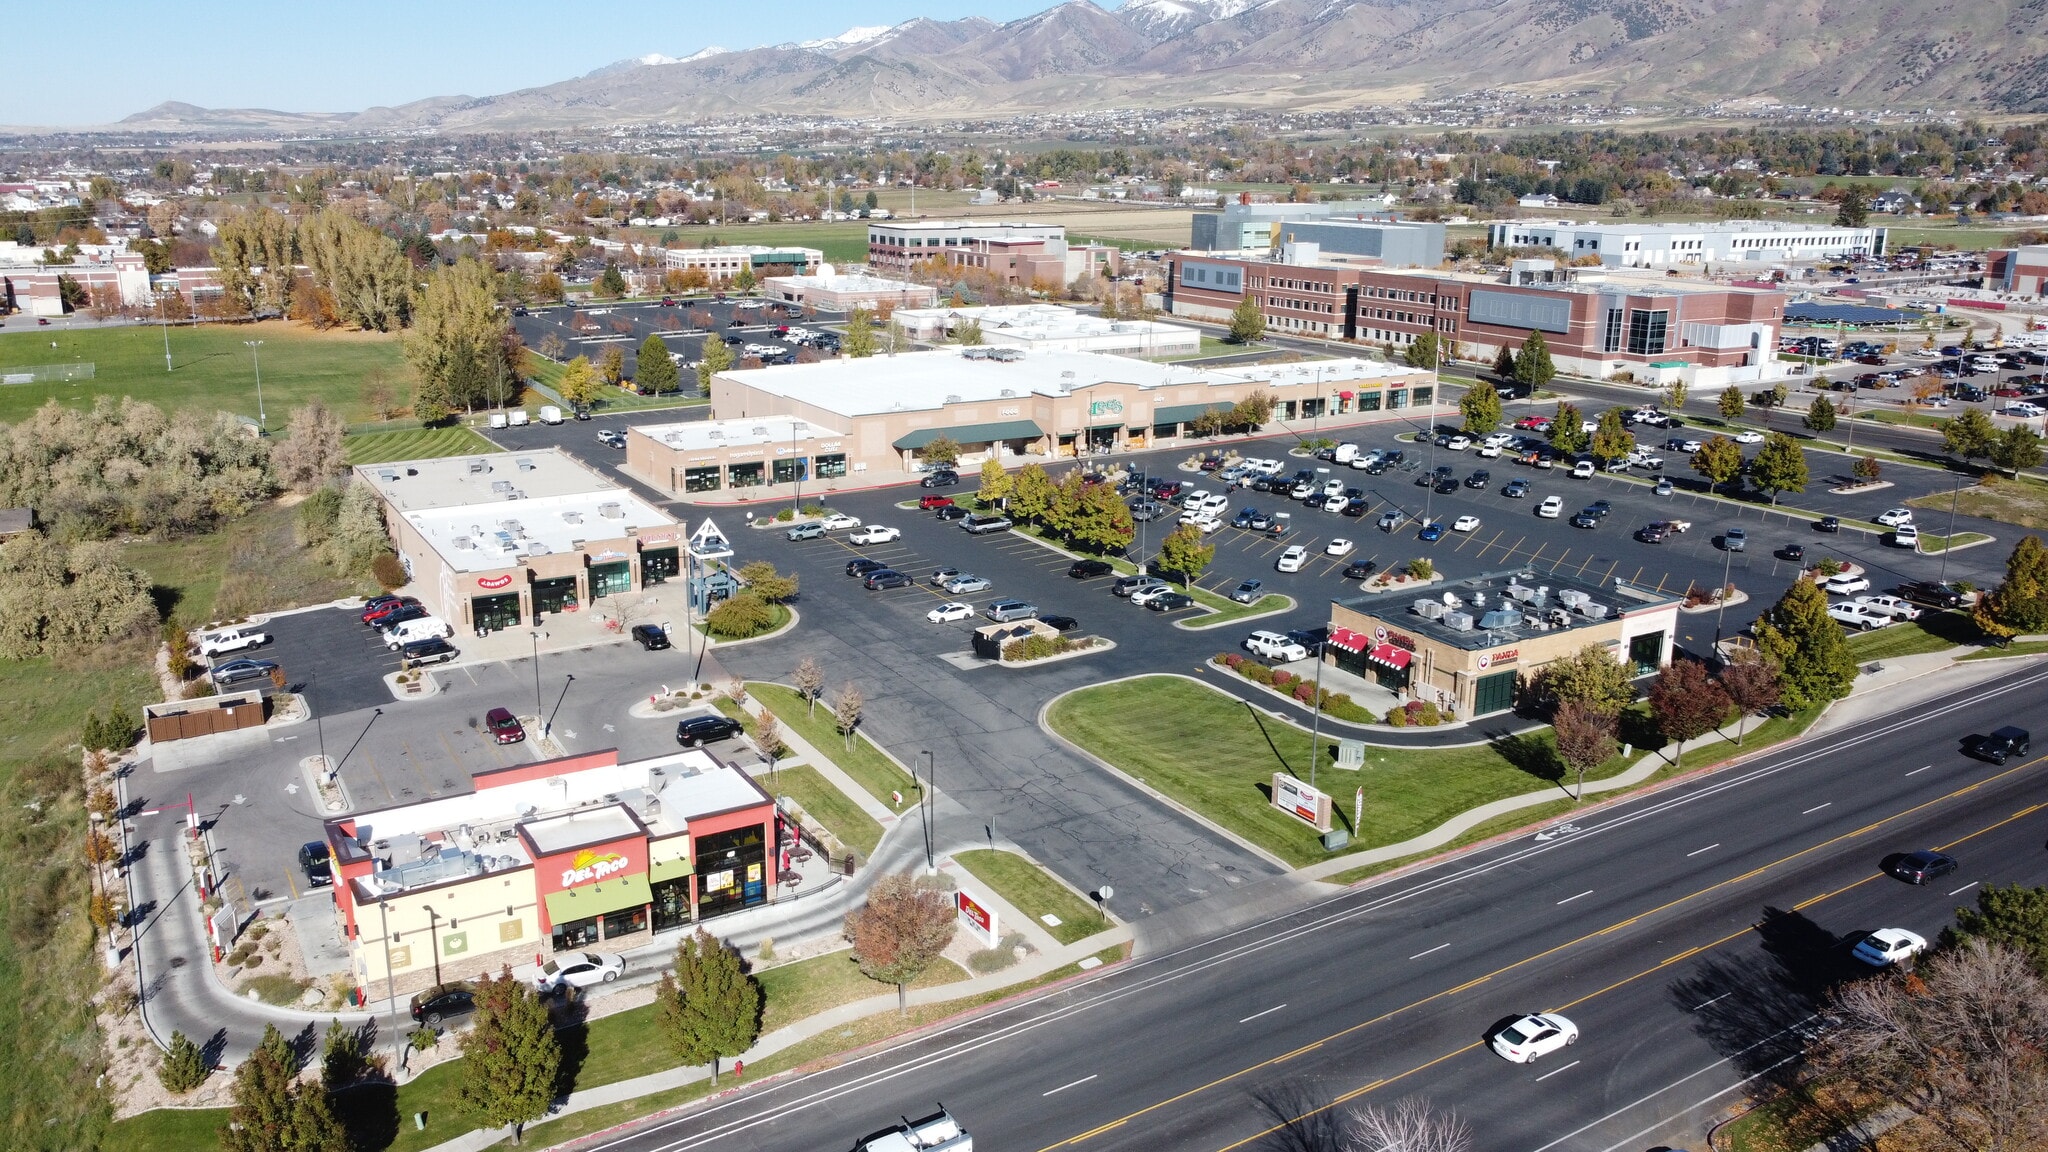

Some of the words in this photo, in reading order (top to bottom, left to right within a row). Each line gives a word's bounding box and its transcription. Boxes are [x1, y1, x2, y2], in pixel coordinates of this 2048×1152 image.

[481, 577, 509, 587] J.DAWGS
[1492, 649, 1518, 661] PANDA
[561, 868, 594, 887] DEL
[593, 857, 628, 879] TACO
